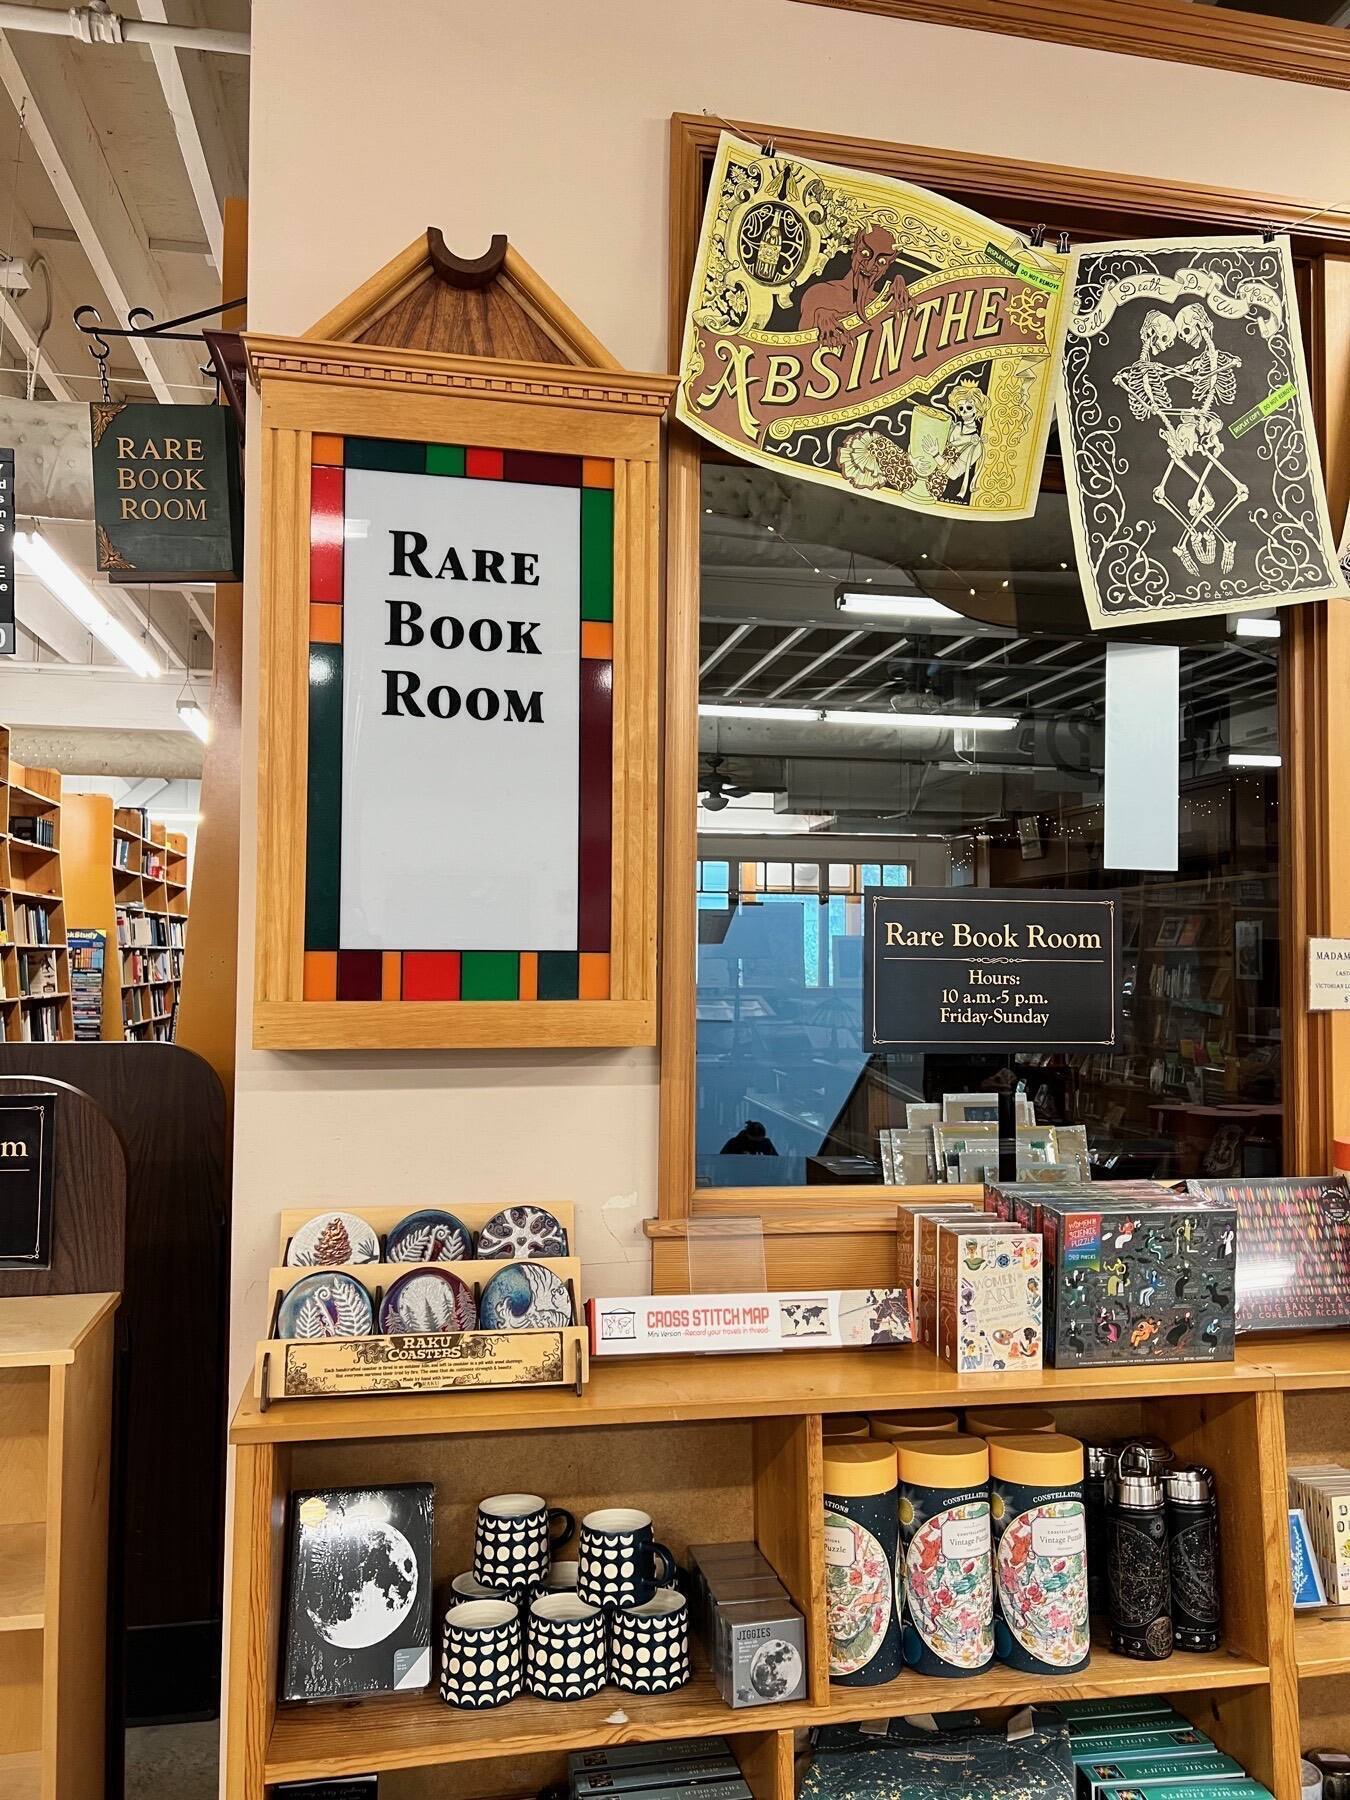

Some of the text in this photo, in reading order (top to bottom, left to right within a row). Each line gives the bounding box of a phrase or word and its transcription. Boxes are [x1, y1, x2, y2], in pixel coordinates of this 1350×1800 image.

[1073, 273, 1279, 334] Till Death Do Us Part
[696, 286, 1011, 443] ABSINTHE
[116, 437, 205, 461] RARE
[116, 467, 207, 491] BOOK
[119, 498, 208, 522] ROOM
[388, 530, 540, 586] RARE
[385, 600, 543, 655] BOOK
[381, 669, 545, 723] ROOM
[884, 922, 1102, 949] Rare Book Room
[968, 969, 1021, 985] Hours:
[942, 989, 959, 1004] 10
[1015, 992, 1049, 1008] p.m.
[940, 1007, 1050, 1027] Friday-Sunday
[1071, 1237, 1095, 1248] PUZZLE
[1285, 1303, 1310, 1311] BALL
[647, 1307, 769, 1328] CROSS STITCH MAP
[403, 1336, 452, 1349] RAKU
[388, 1345, 462, 1361] COASTERS
[950, 1538, 975, 1546] Vintage
[1039, 1535, 1066, 1545] Vintage
[737, 1628, 771, 1640] JIGGIES
[1074, 1740, 1114, 1749] COSMIC
[1120, 1736, 1159, 1745] LIGHTS
[1136, 1766, 1178, 1775] LIGHTS
[1184, 1762, 1225, 1771] COSMIC
[1160, 1789, 1255, 1800] COSMIC LIGHTS
